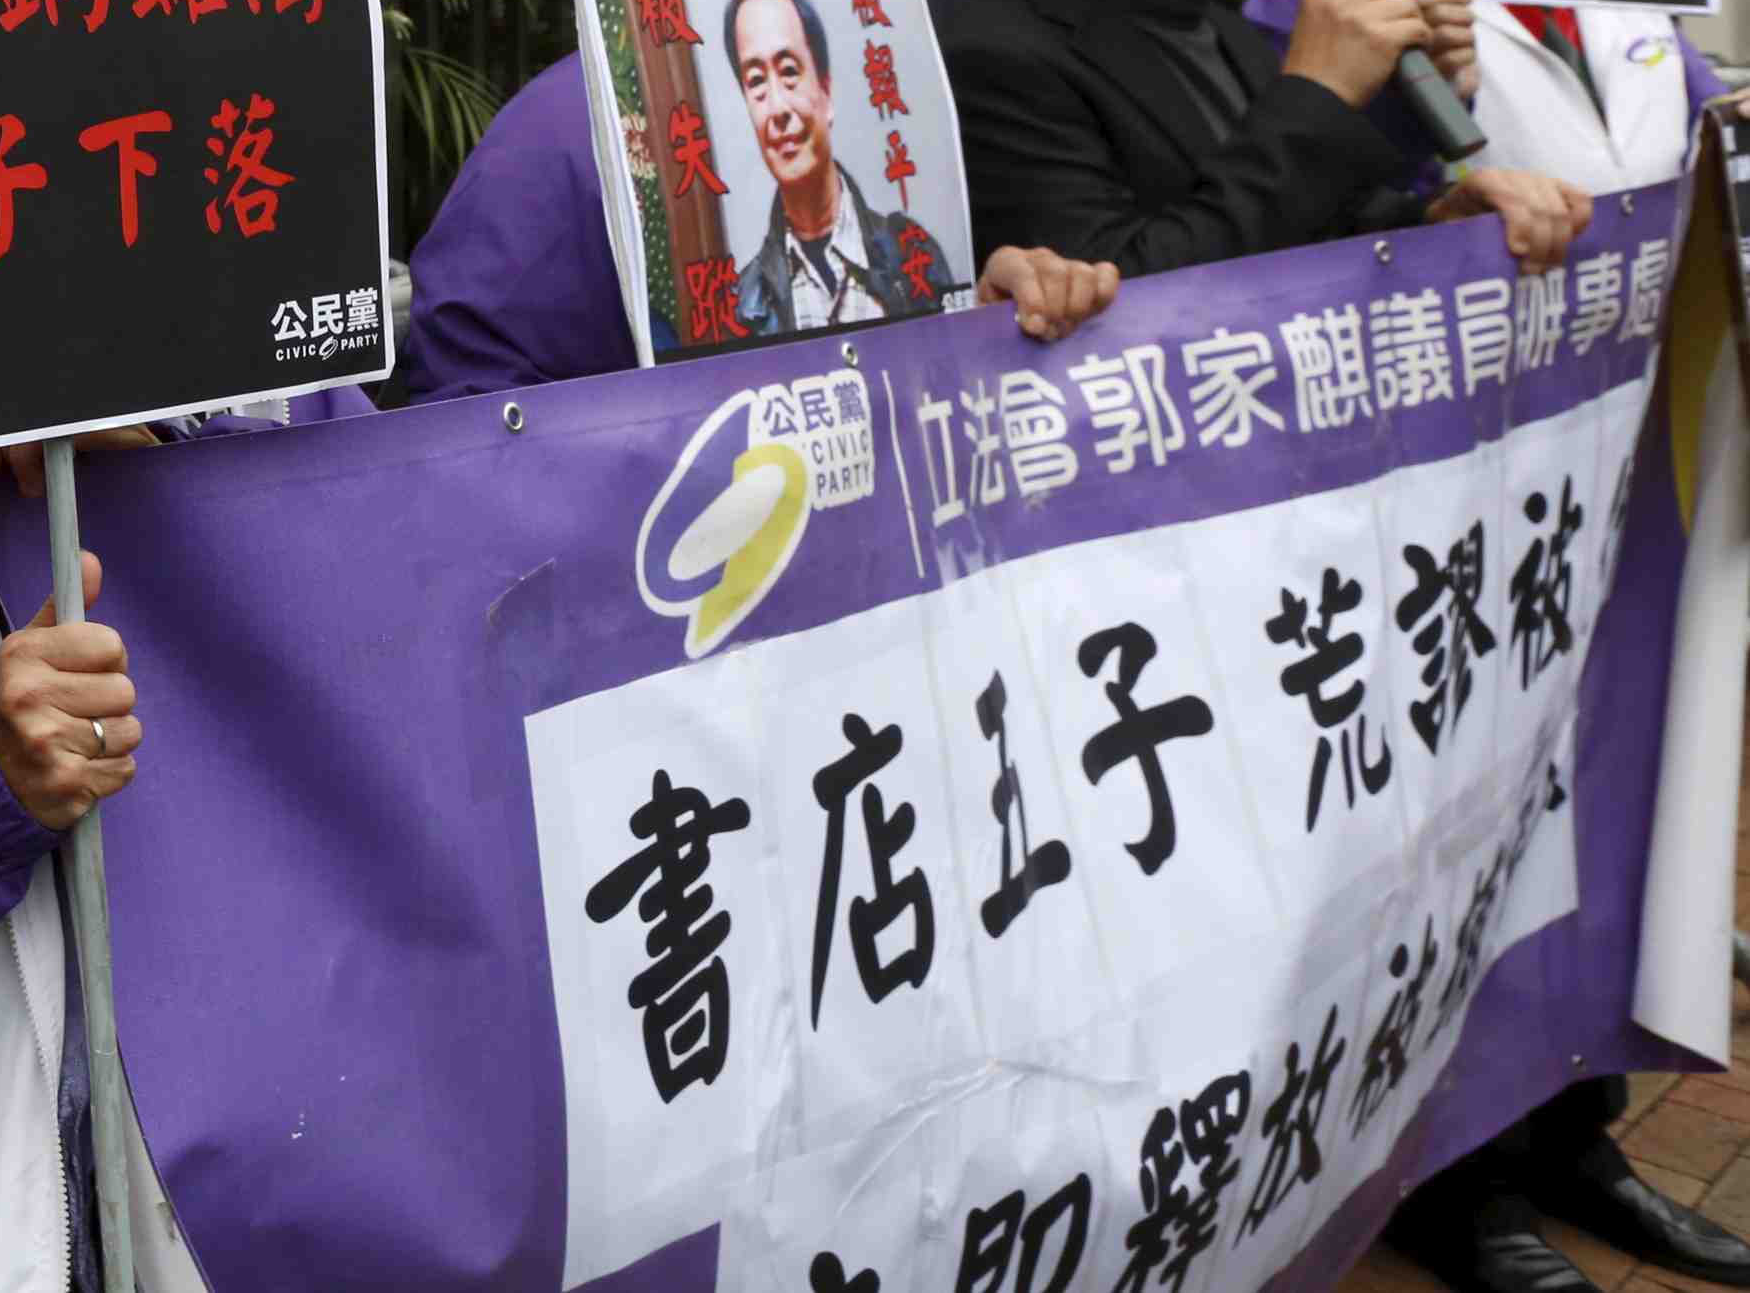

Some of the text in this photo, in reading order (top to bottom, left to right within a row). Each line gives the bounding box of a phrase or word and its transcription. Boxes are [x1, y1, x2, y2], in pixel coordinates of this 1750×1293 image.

[270, 287, 379, 342] 公民黨
[275, 332, 379, 362] CIVIC PARTY
[763, 380, 867, 437] 公民黨
[810, 428, 871, 465] CIVIC
[816, 460, 871, 499] PARTY
